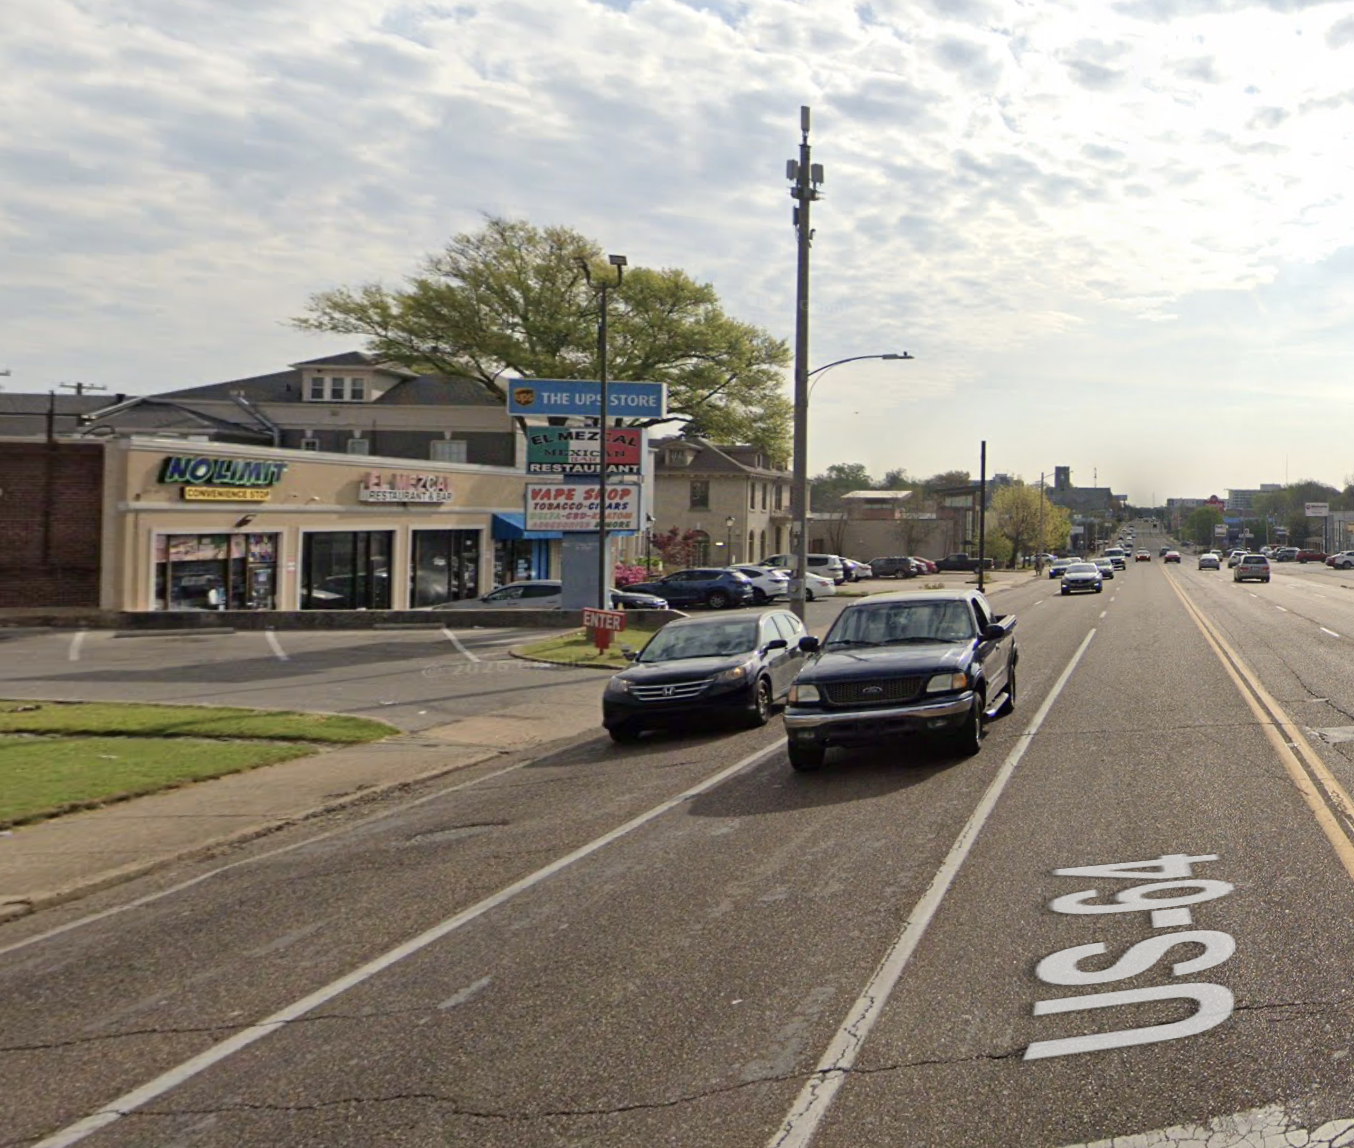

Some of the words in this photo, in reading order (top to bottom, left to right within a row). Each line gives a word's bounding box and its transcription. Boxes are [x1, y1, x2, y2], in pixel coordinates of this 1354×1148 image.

[541, 392, 570, 405] THE
[574, 393, 603, 406] UPS
[610, 394, 657, 407] STORE
[530, 435, 554, 445] EL
[187, 488, 248, 499] CONVENIENCE
[368, 490, 427, 501] RESTAURANT
[531, 488, 576, 500] VAPE
[583, 488, 631, 500] SHOP
[533, 502, 629, 511] TOBACCO-CIARS
[583, 611, 621, 630] ENTER
